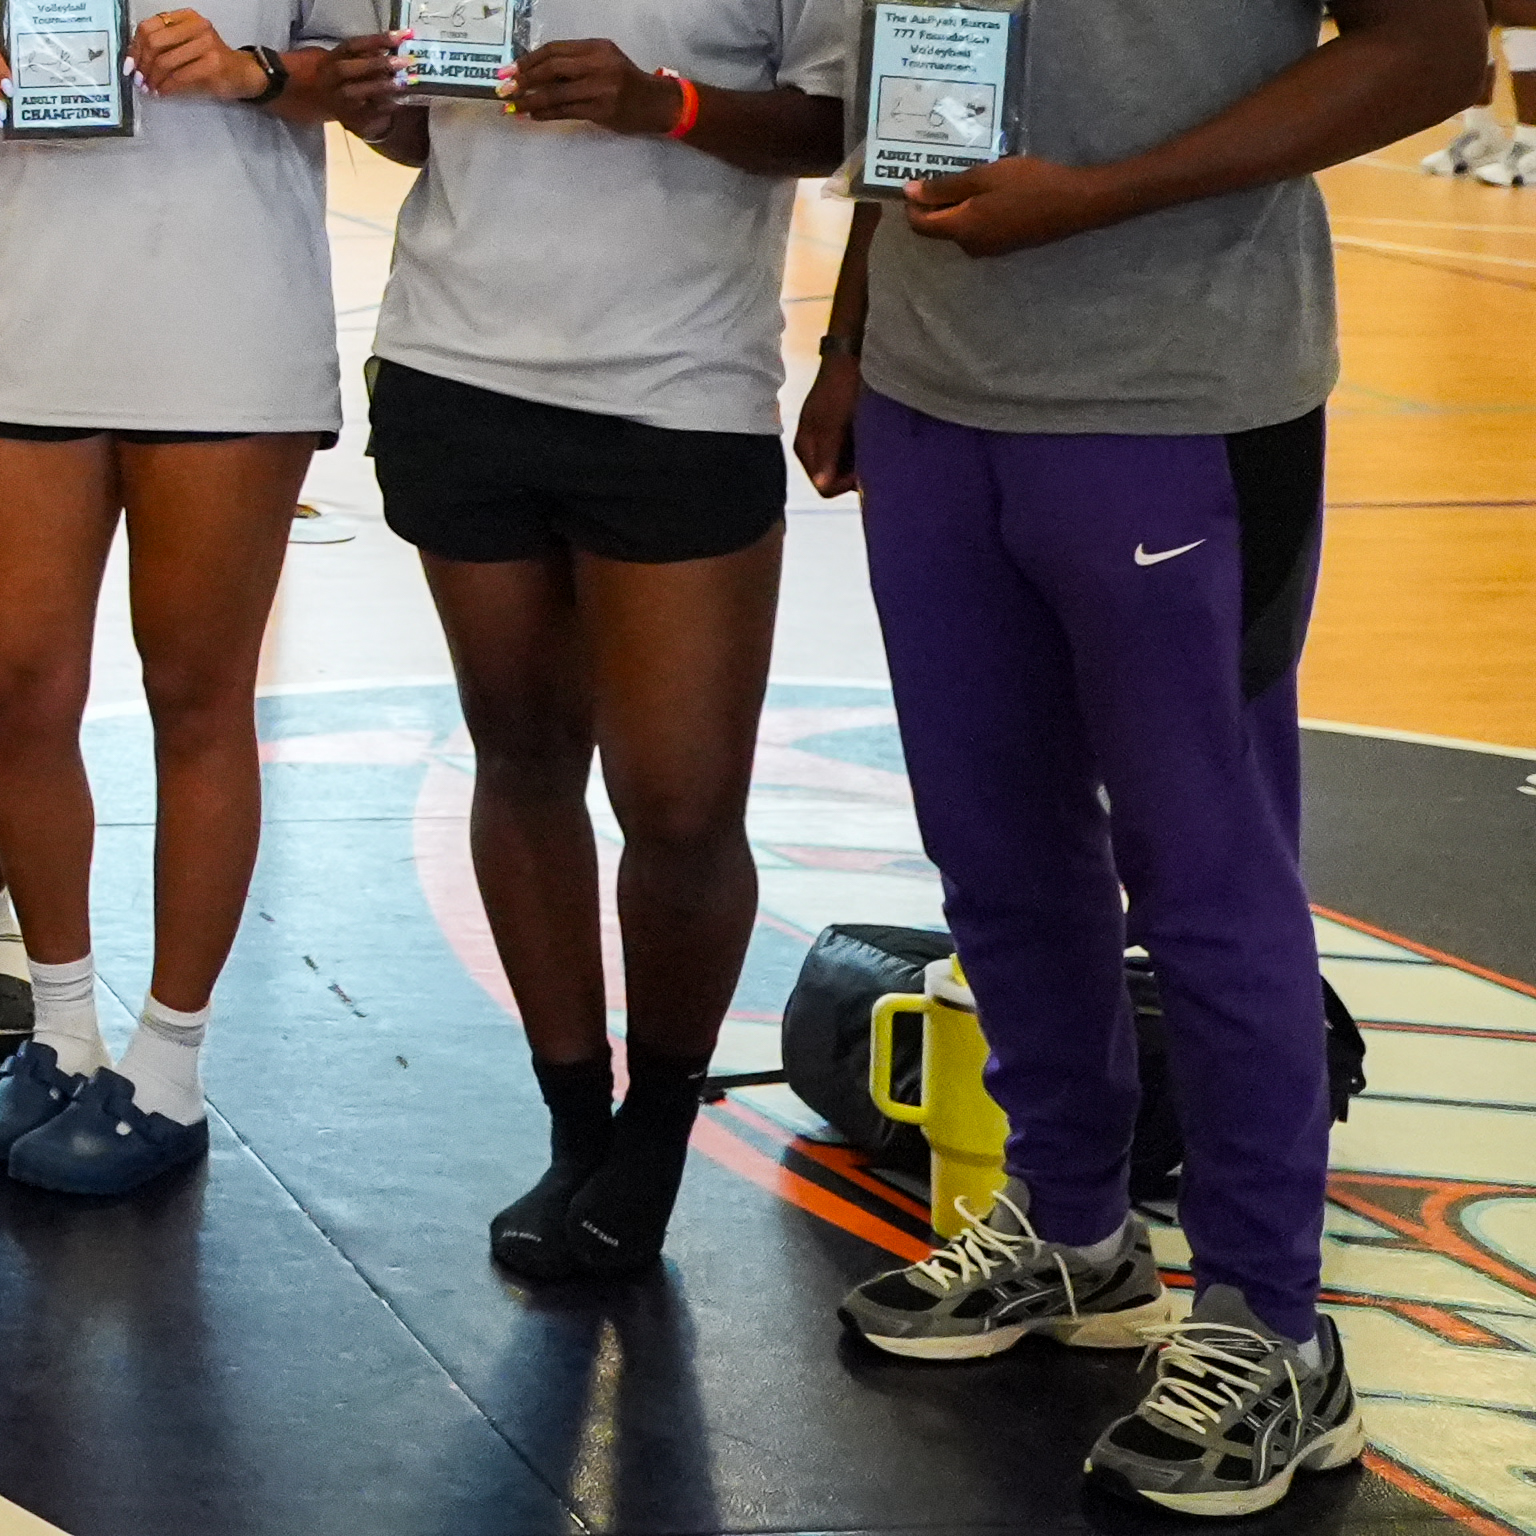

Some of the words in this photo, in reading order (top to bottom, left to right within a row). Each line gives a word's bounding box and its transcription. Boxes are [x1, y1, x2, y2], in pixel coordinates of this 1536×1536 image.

[886, 13, 906, 23] The
[893, 29, 914, 38] 777
[21, 108, 111, 121] CHAMPIONS
[877, 149, 923, 162] ADULT
